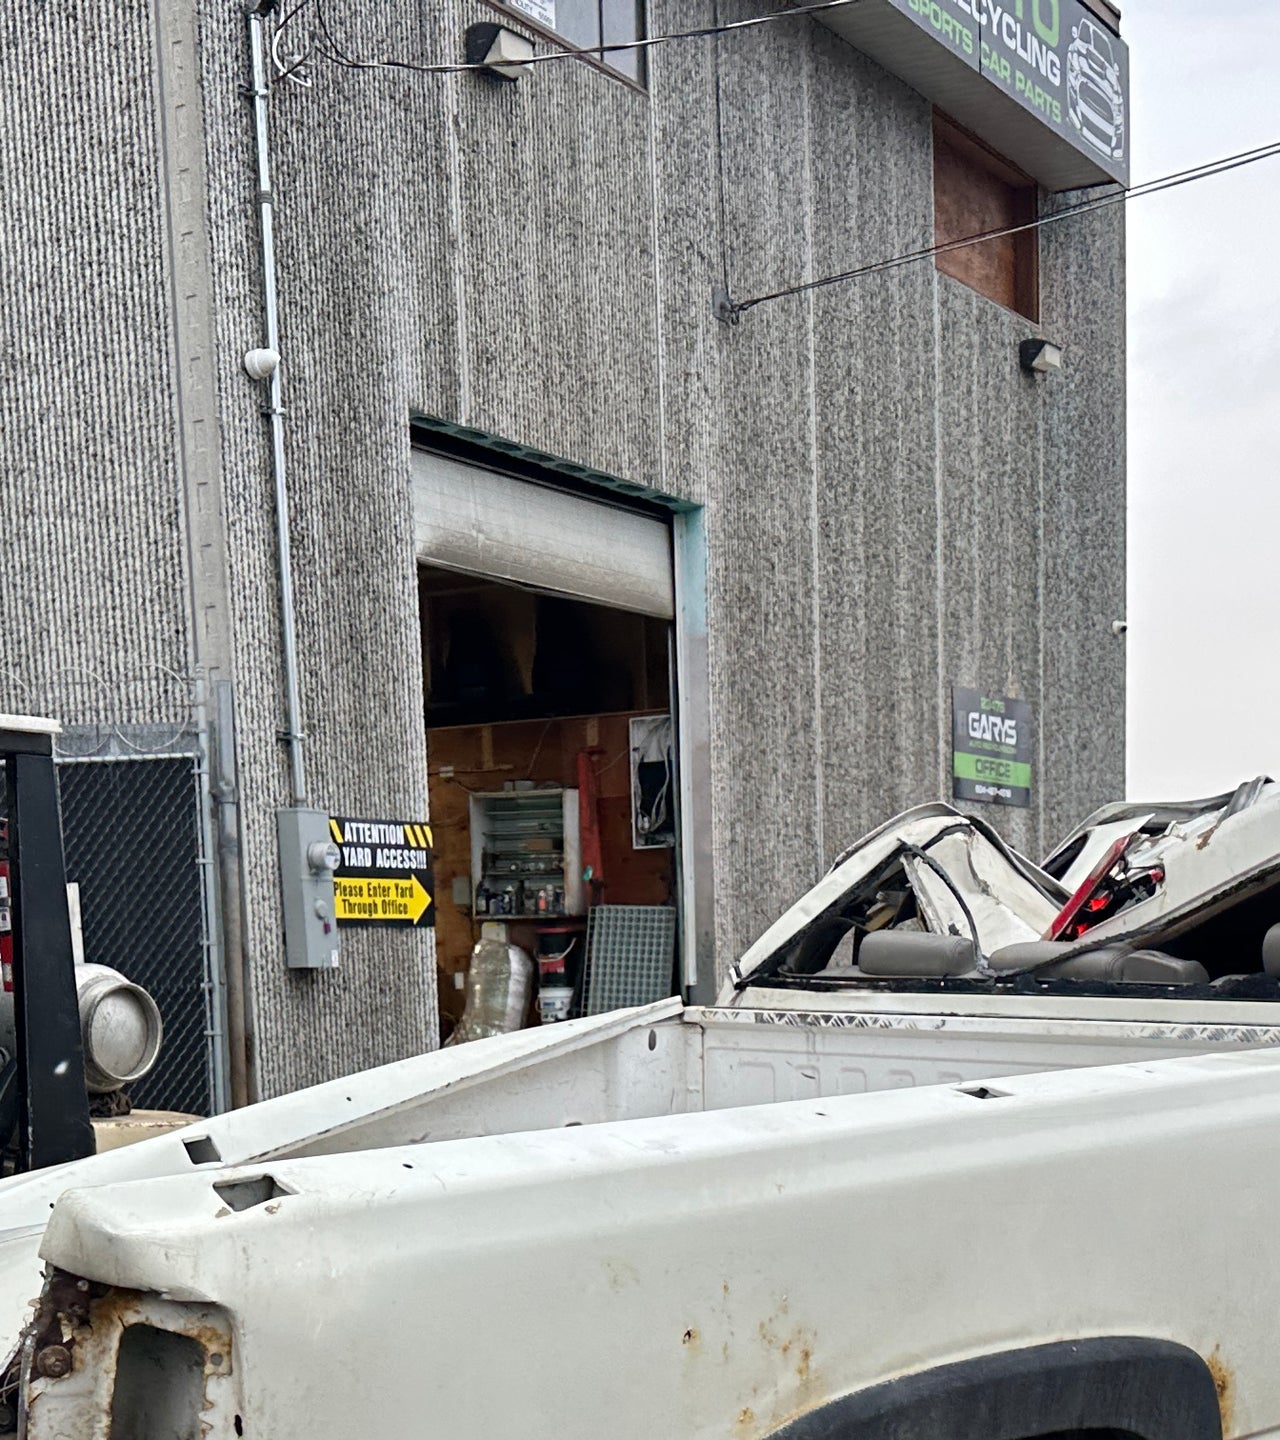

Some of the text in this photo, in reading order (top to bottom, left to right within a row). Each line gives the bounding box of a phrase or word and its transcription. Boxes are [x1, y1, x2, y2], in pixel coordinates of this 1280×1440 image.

[980, 41, 1011, 83] CAR
[1015, 70, 1062, 124] PARTS
[968, 711, 1017, 745] GARYS
[975, 758, 1011, 778] OFFICE
[344, 822, 405, 845] ATTENTION
[342, 847, 427, 870] YARD ACCESS!!!
[334, 881, 414, 898] Please Enter Yard
[342, 899, 408, 917] Through Office
